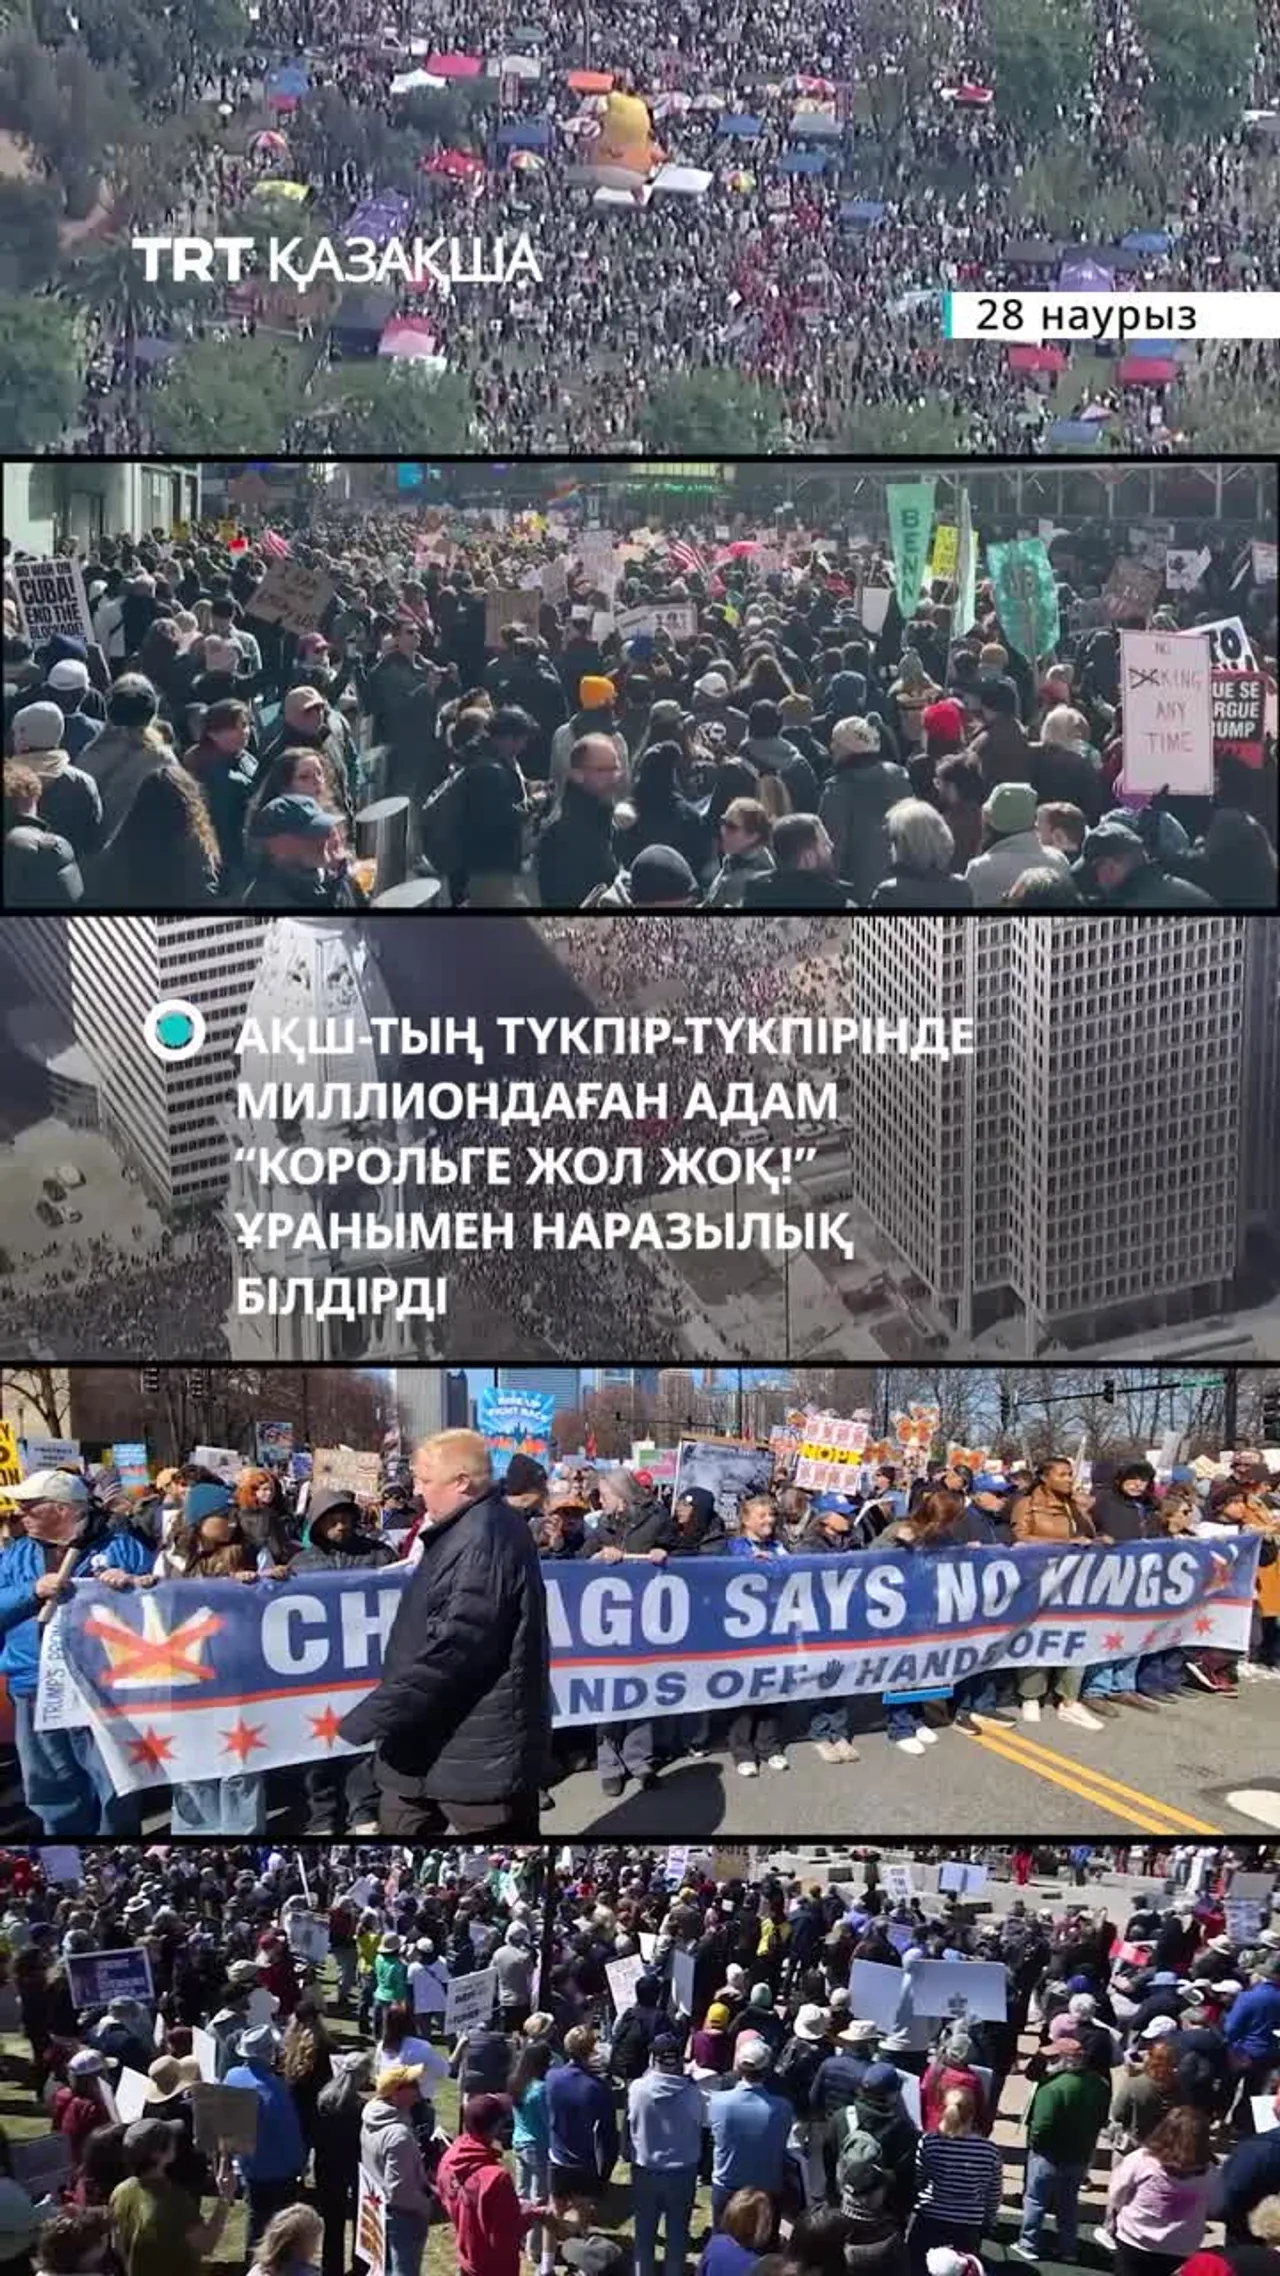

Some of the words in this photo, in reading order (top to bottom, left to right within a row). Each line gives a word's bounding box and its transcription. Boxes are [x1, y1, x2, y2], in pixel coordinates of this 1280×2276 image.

[20, 576, 78, 605] CUBA!
[25, 605, 53, 624] END
[53, 602, 82, 622] THE
[1212, 682, 1235, 699] UE
[1239, 682, 1261, 699] SE
[1156, 701, 1188, 720] ANY
[1213, 701, 1260, 720] RGUE
[1211, 721, 1256, 739] UMP
[1143, 732, 1193, 754] TIME
[261, 1574, 691, 1675] CHAGO
[724, 1565, 907, 1639] SAYS
[936, 1560, 1021, 1625] NO
[1039, 1552, 1199, 1607] KINGS
[552, 1671, 688, 1716] NDS
[706, 1664, 809, 1700] OFF
[1010, 1629, 1087, 1659] OFF
